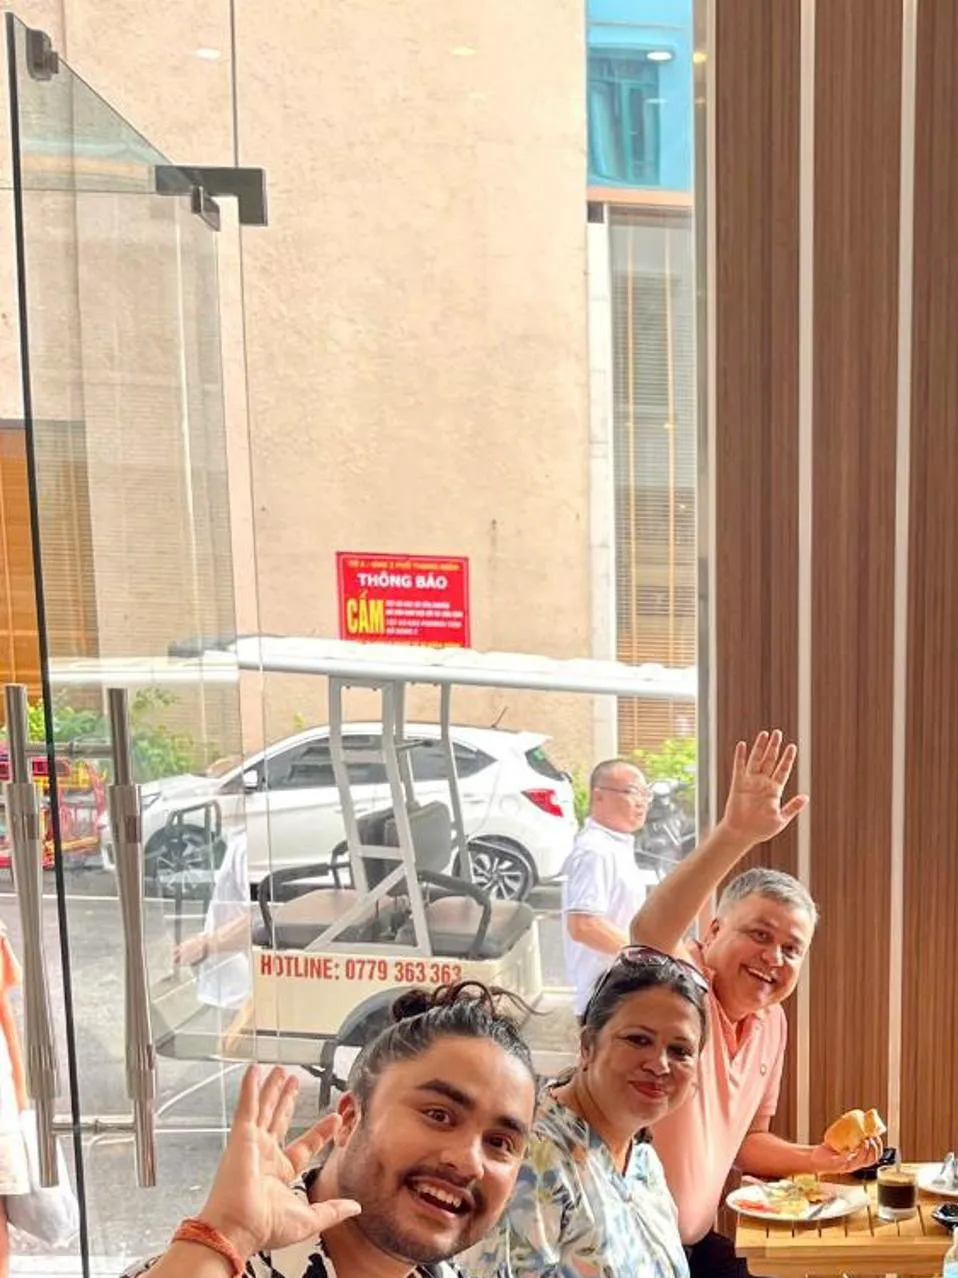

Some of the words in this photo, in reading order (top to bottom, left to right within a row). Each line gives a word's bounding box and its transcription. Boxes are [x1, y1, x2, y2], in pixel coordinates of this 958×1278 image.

[357, 571, 412, 588] THÔNG
[416, 572, 448, 589] BÁO
[261, 954, 340, 980] HOTLINE:
[345, 958, 388, 980] 0779
[394, 961, 425, 982] 363
